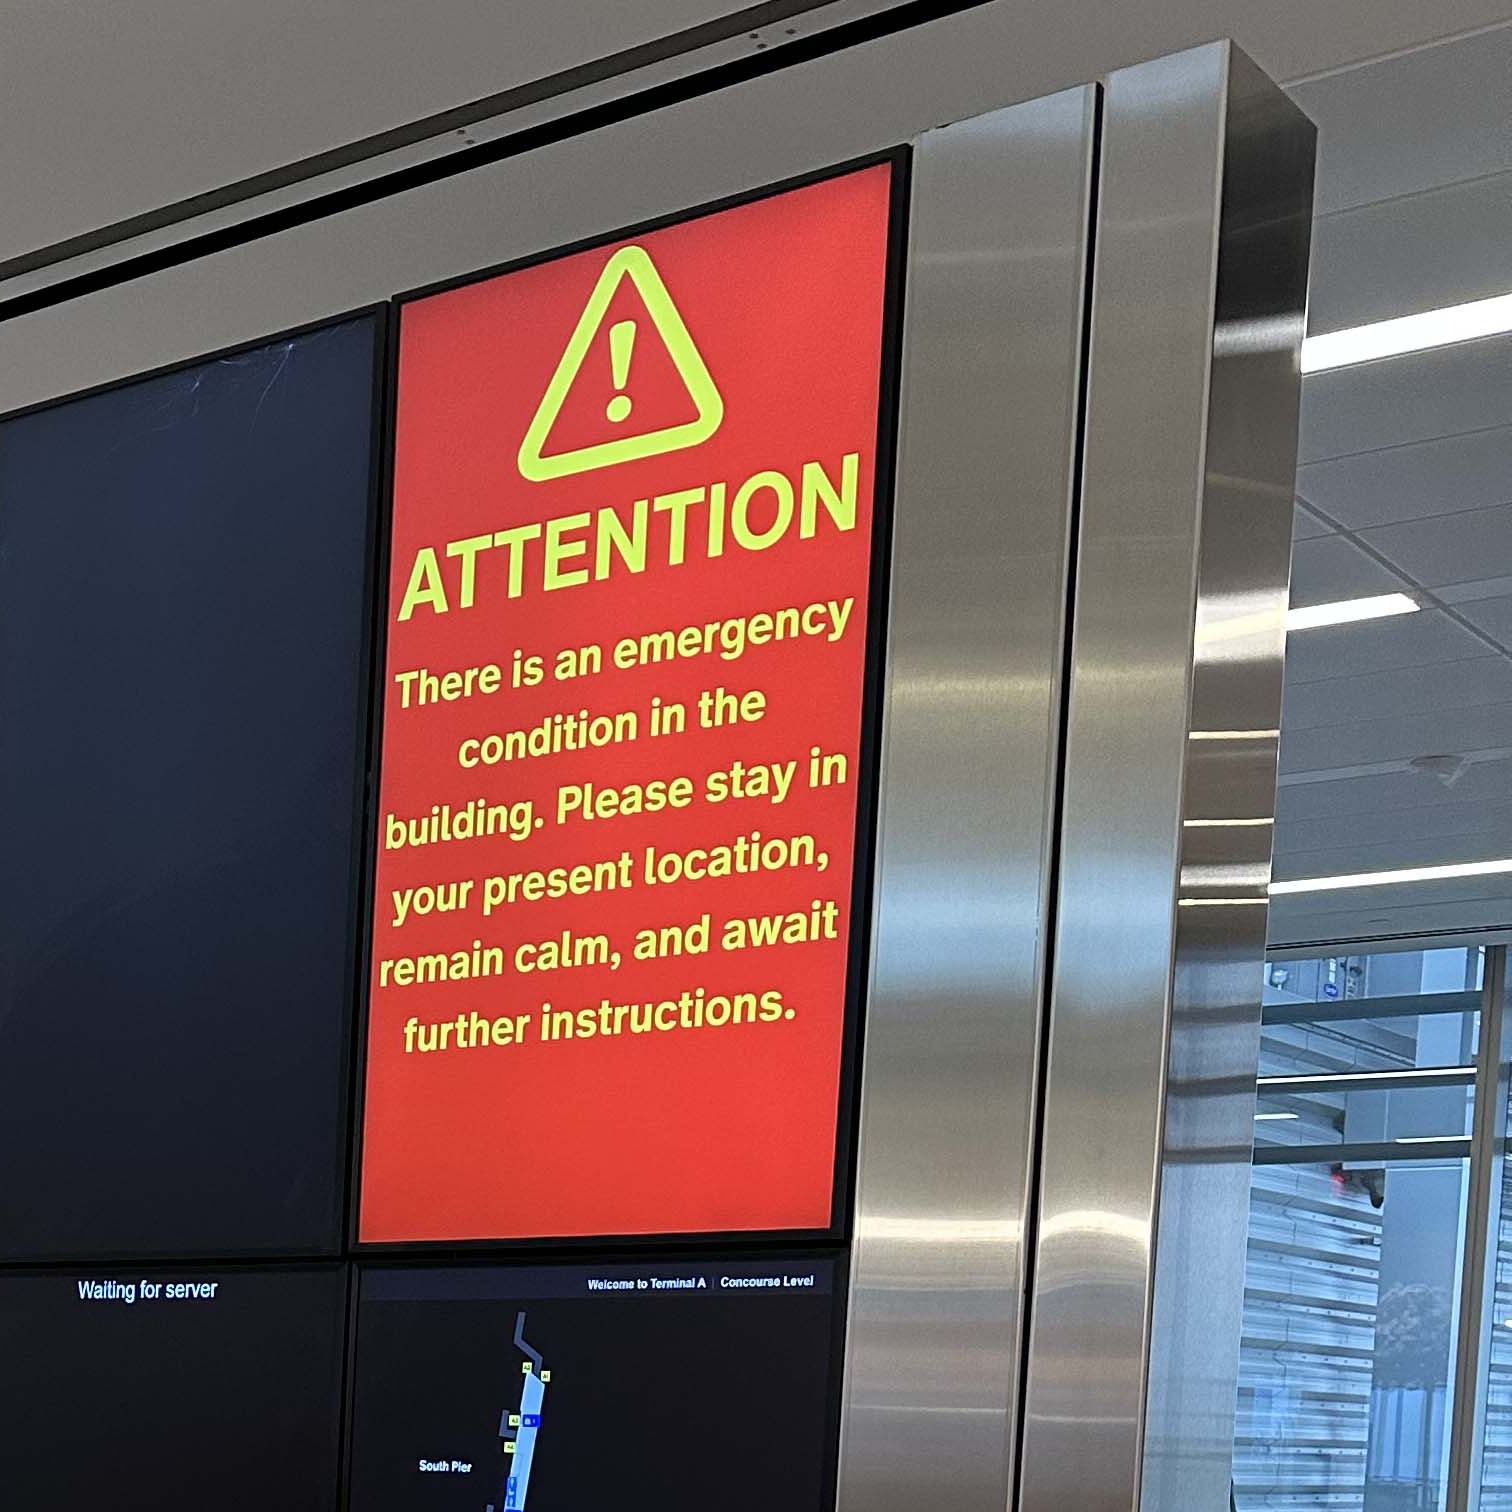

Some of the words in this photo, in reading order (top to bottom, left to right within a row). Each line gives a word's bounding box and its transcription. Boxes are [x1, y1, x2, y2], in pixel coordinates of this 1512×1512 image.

[397, 452, 859, 622] ATTENTION
[394, 664, 502, 709] There
[512, 649, 544, 689] is
[554, 645, 602, 681] an
[613, 597, 854, 669] emergency
[458, 709, 638, 769] condition
[650, 696, 685, 737] in
[697, 687, 766, 729] the
[385, 798, 544, 850] building.
[556, 777, 694, 825] Please
[705, 760, 797, 804] stay
[809, 746, 847, 788] in
[392, 880, 474, 928] your
[483, 851, 634, 916] present
[644, 831, 829, 885] location,
[379, 939, 504, 988] remain
[514, 930, 621, 973] calm,
[633, 913, 711, 960] and
[721, 899, 839, 951] await
[403, 1011, 531, 1053] further
[540, 987, 796, 1041] instructions.
[77, 1280, 136, 1304] Waiting
[139, 1279, 163, 1299] for
[165, 1282, 219, 1299] server
[587, 1278, 635, 1290] Welcome
[637, 1278, 648, 1290] to
[649, 1277, 695, 1289] Terminal
[697, 1277, 707, 1289] A
[720, 1276, 781, 1288] Concourse
[783, 1275, 814, 1288] Level
[419, 1459, 450, 1473] South
[451, 1460, 473, 1473] Pier
